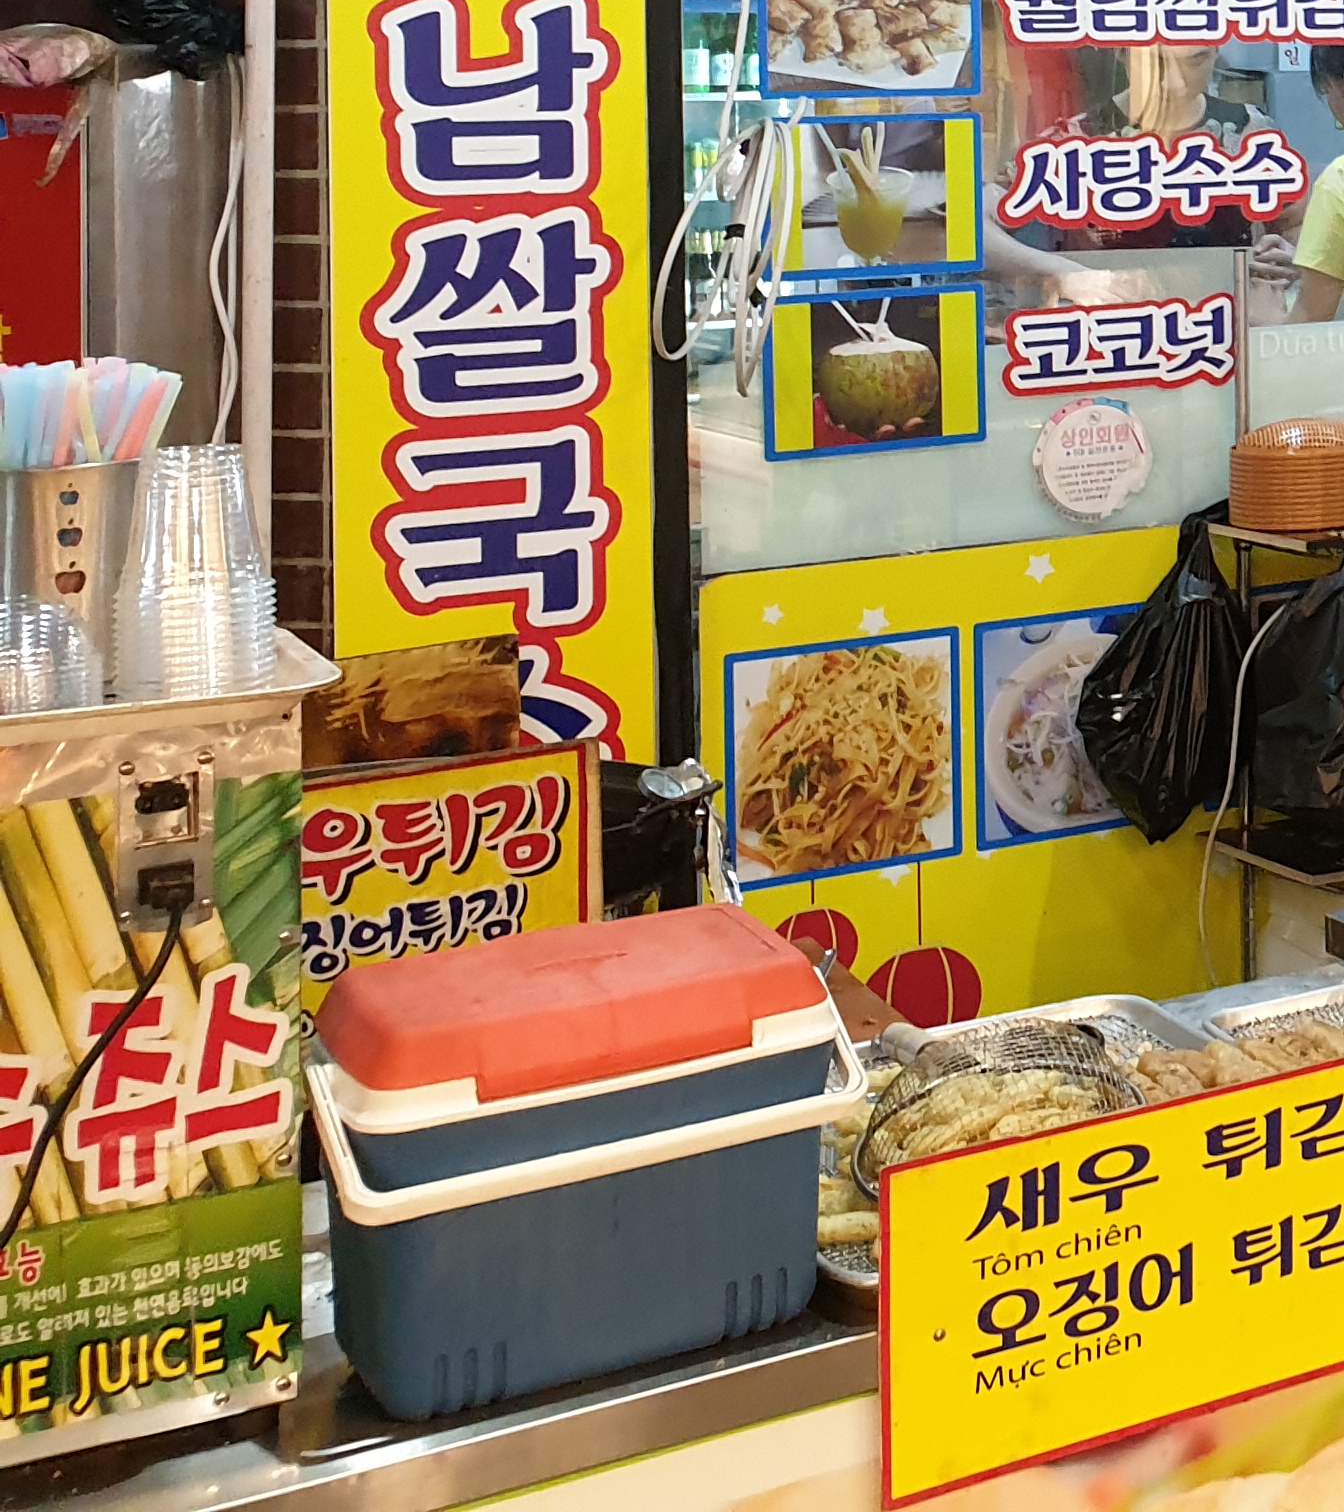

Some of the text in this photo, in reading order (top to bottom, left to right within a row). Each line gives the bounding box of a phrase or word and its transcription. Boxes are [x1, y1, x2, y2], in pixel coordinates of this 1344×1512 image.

[1008, 134, 1306, 221] 사탕수수
[1012, 299, 1236, 387] 코코넛
[965, 1144, 1159, 1242] 새우
[972, 1224, 1142, 1280] Tôm chiên
[972, 1241, 1193, 1359] 오징어
[71, 1318, 225, 1414] JUICE
[975, 1332, 1142, 1394] Mực chiên
